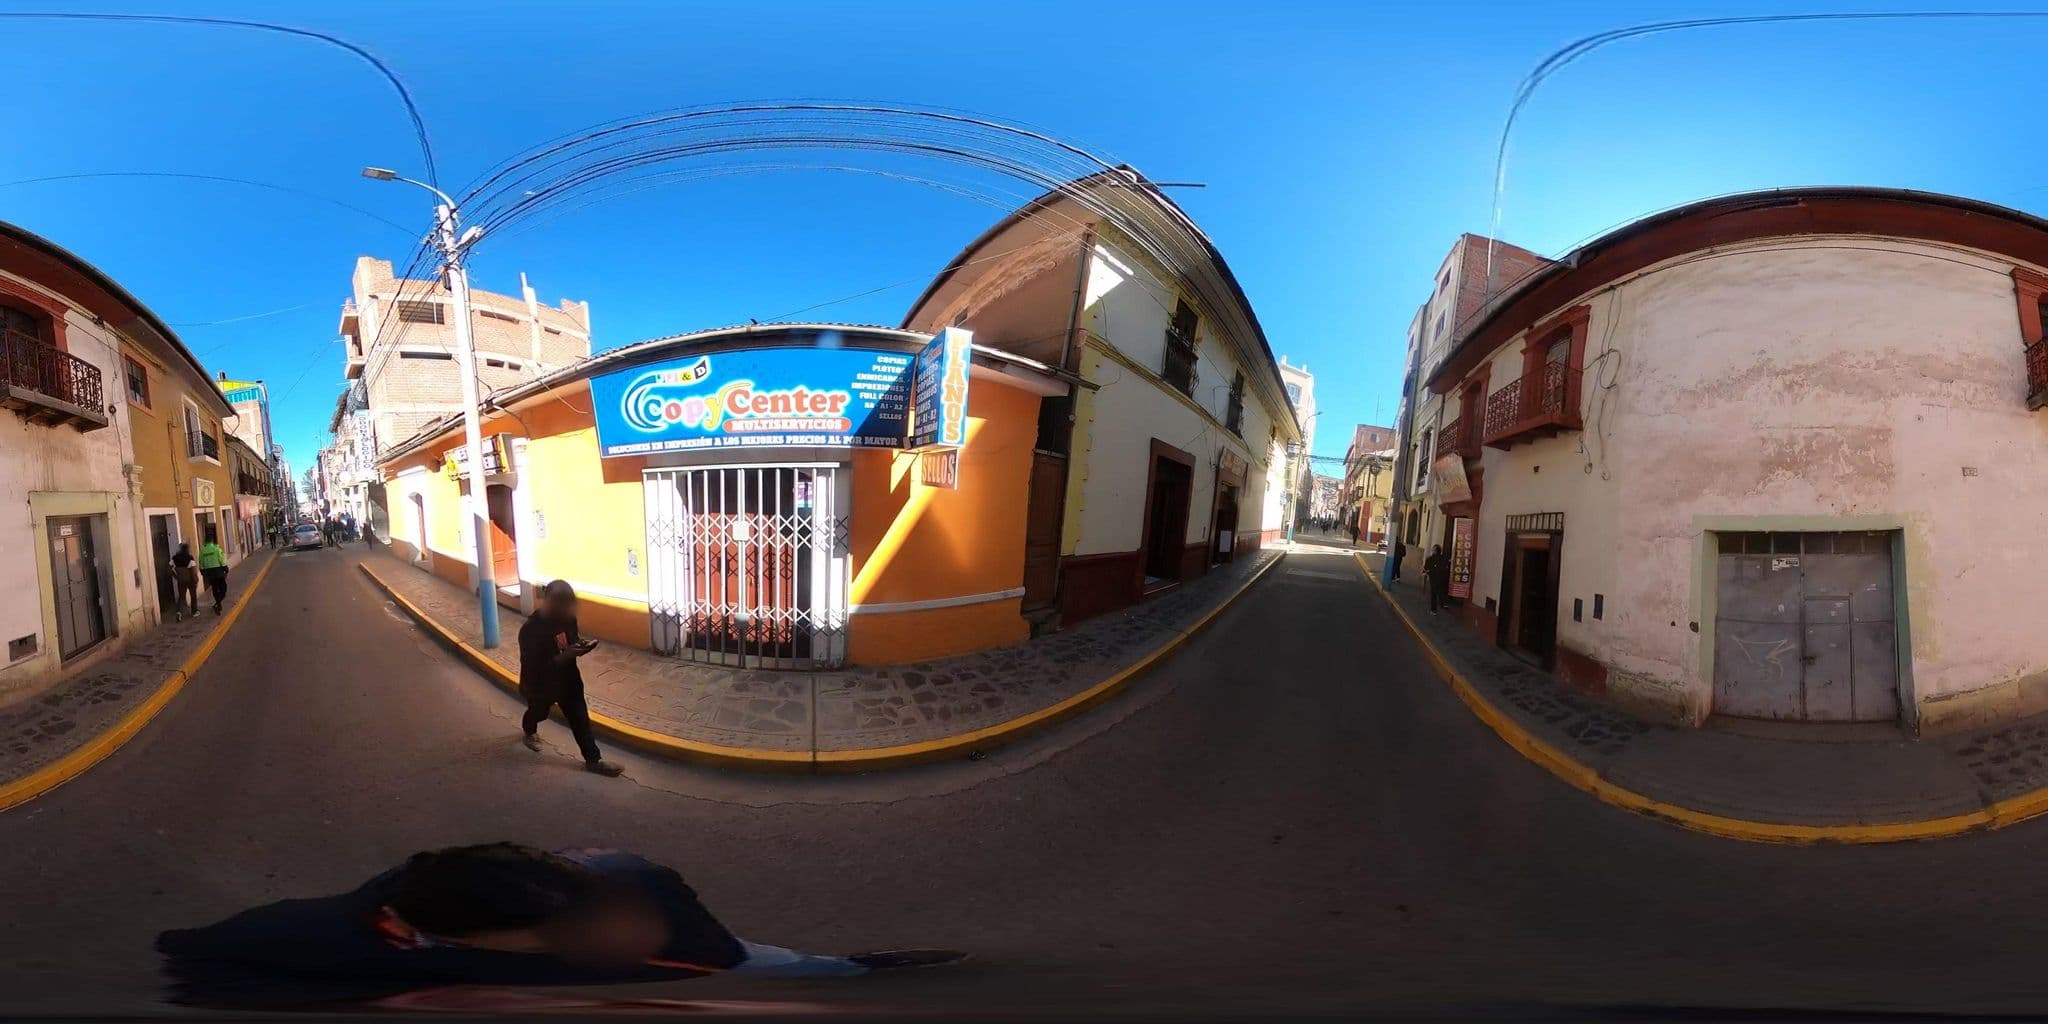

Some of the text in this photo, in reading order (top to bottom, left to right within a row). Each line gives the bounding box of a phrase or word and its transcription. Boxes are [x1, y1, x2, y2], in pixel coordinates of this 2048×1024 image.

[859, 392, 904, 402] FULL COLOR
[944, 334, 966, 441] PLANOS
[731, 418, 843, 431] MULTISERVICIOS
[714, 437, 722, 446] A
[723, 436, 740, 446] LOS
[741, 436, 785, 445] MEJORES
[786, 435, 827, 445] PRECIOS
[827, 436, 841, 444] AL
[843, 436, 863, 445] POR
[864, 437, 898, 445] MAYOR
[923, 454, 955, 485] SELLOS
[1461, 533, 1471, 583] COPIAS
